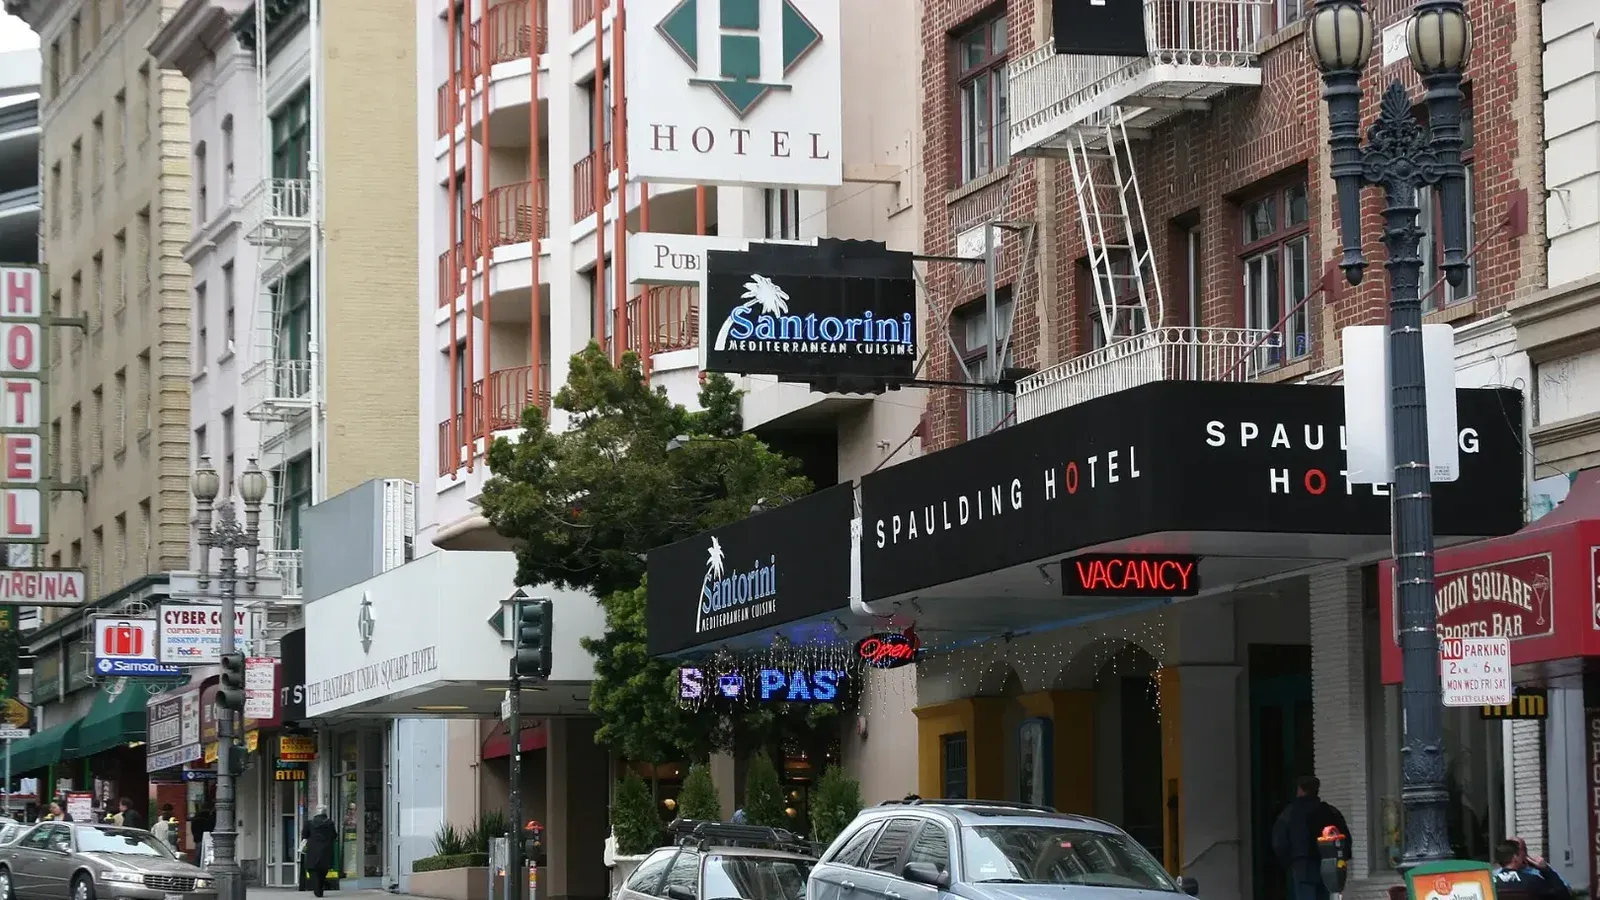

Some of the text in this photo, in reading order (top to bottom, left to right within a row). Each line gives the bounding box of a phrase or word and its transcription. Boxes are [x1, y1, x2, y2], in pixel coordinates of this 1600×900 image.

[650, 123, 830, 160] HOTEL
[730, 306, 912, 344] Santorini
[728, 340, 915, 355] MEDITERRANEAN CUISINE
[8, 272, 32, 534] HOTEL
[1206, 421, 1479, 453] SPAULG
[876, 446, 1140, 549] SPAULDING HOTEL
[1270, 468, 1390, 496] HOE
[702, 554, 776, 614] Santorini
[1076, 559, 1193, 590] VACANCY
[1435, 571, 1533, 616] NION SQUARE
[165, 611, 246, 625] CYBER CY
[701, 599, 777, 632] MEDITERRANEAN CUISINE
[1436, 613, 1523, 640] SPORTS BAR
[177, 647, 204, 655] FedEx
[860, 639, 912, 663] Open
[1444, 640, 1507, 658] NO PARKING
[308, 681, 321, 706] THE
[357, 663, 379, 692] UNION
[381, 654, 409, 690] SQUARE
[412, 646, 438, 676] HOTEL
[1447, 679, 1506, 690] MON WED FRI SAT
[1473, 695, 1506, 703] CLEANING
